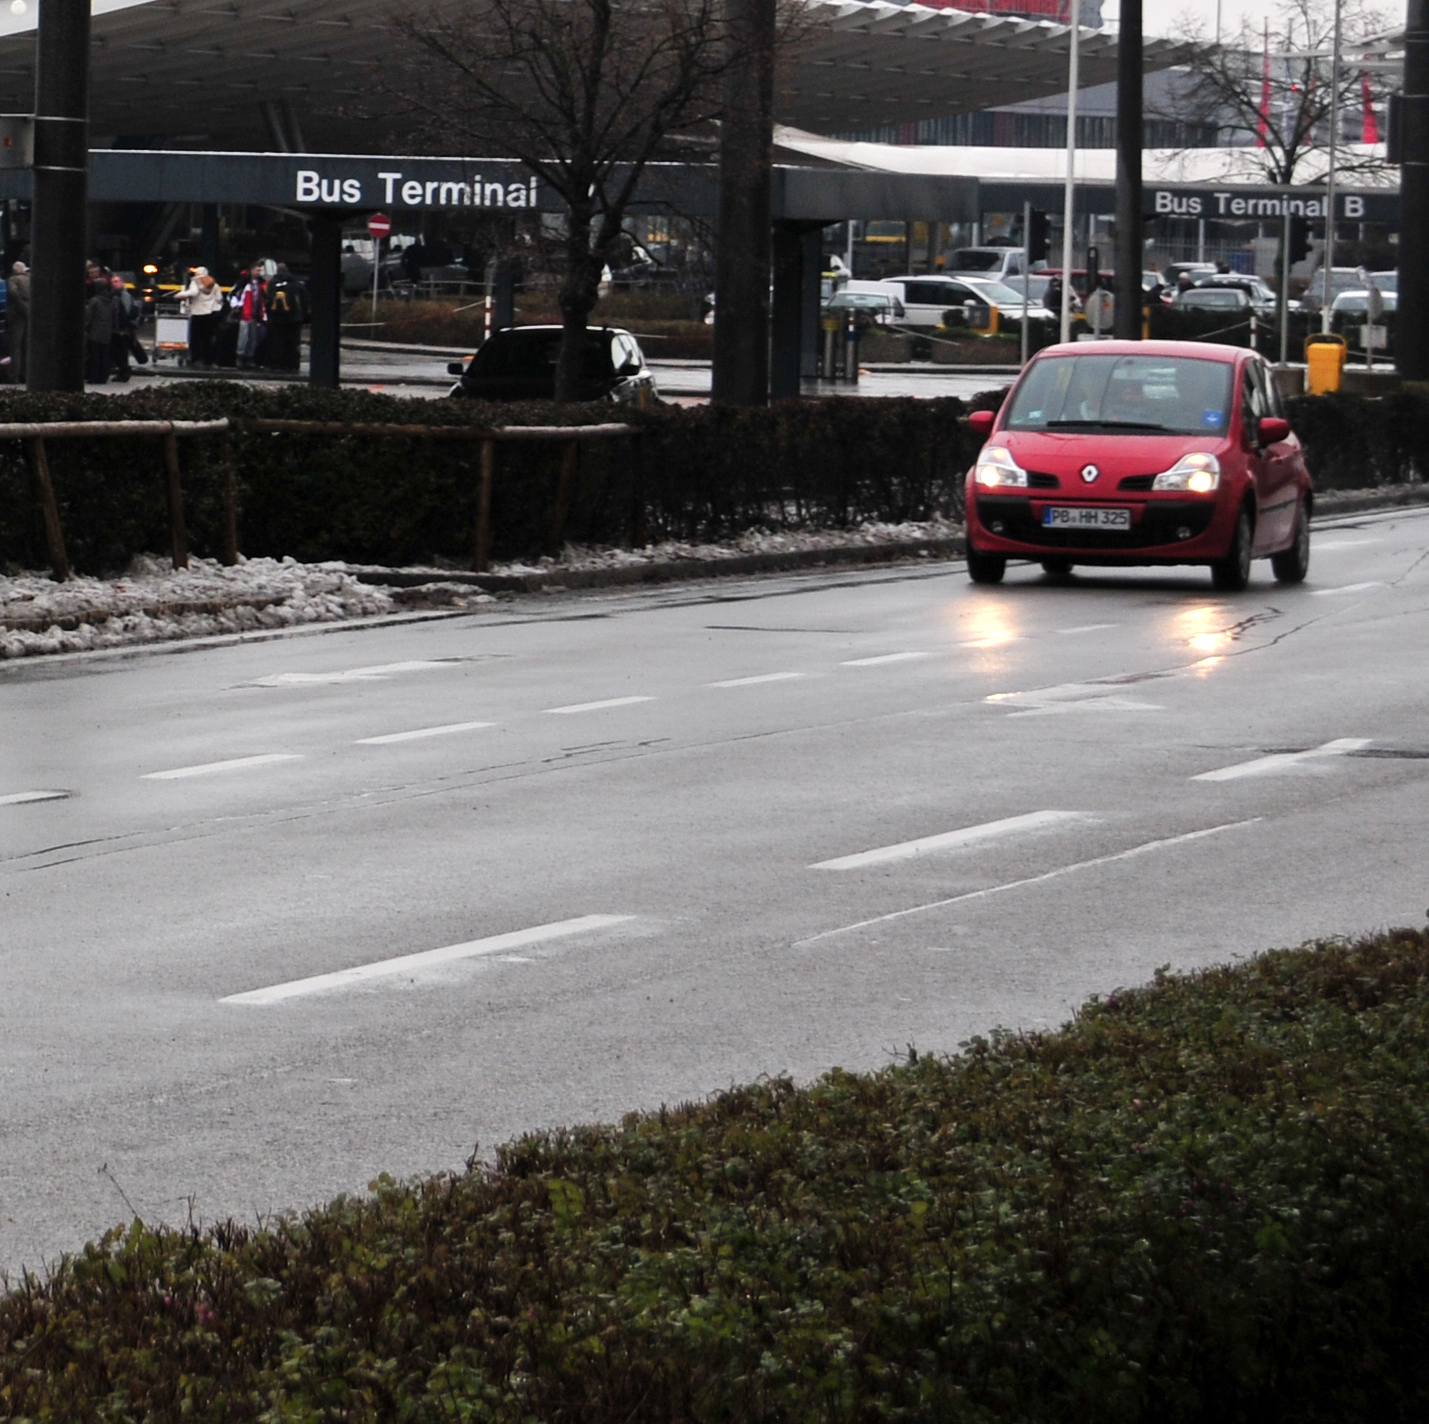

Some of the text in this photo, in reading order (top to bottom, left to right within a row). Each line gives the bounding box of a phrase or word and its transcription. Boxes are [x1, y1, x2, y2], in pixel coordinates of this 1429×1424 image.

[296, 170, 537, 207] Bus Terminal
[1155, 191, 1365, 218] Bus Terminal B
[1052, 509, 1128, 525] PB HH 325
